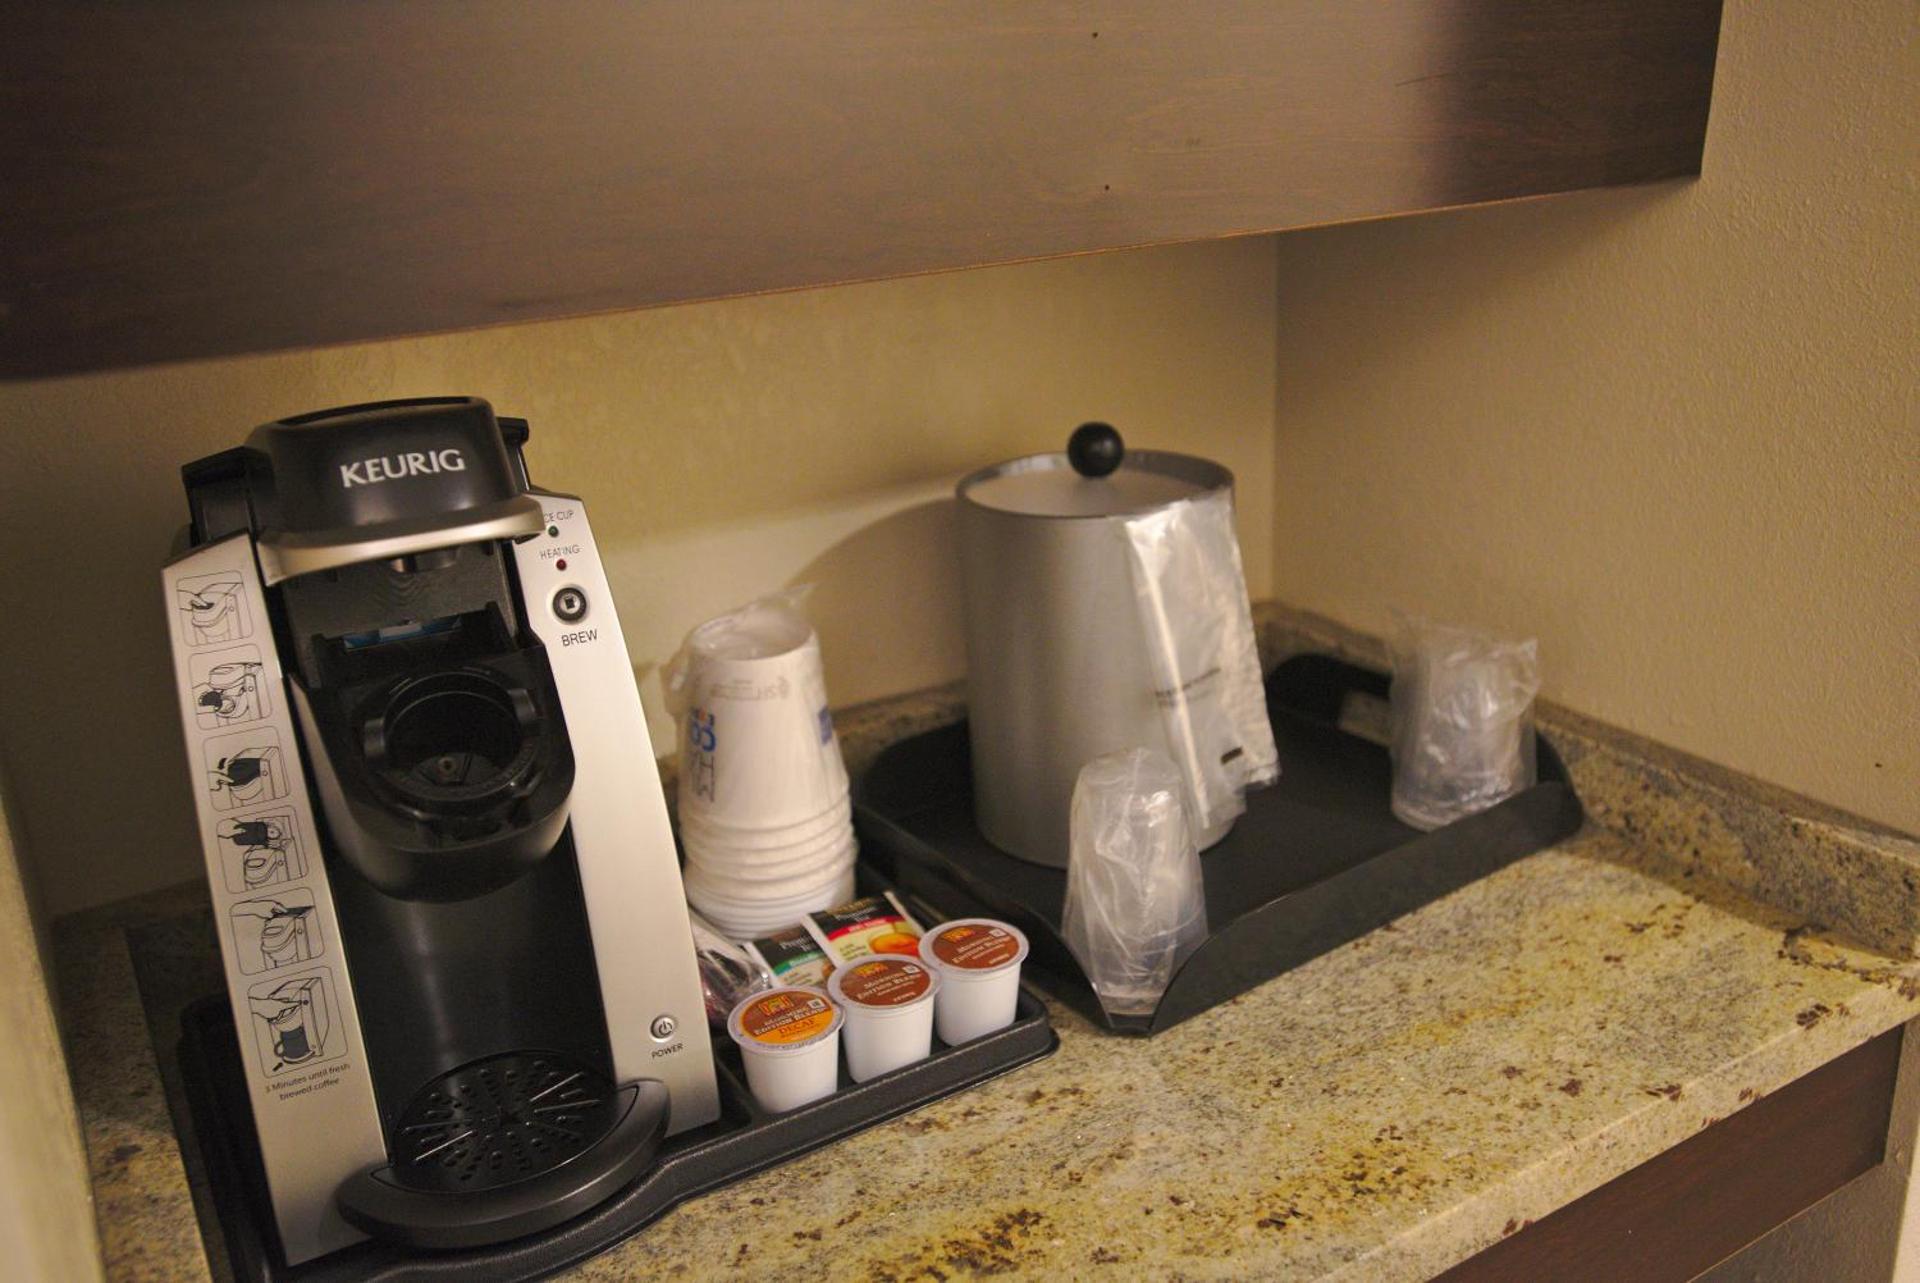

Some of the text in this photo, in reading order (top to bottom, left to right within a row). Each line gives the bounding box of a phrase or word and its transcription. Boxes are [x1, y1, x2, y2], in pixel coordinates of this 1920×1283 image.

[340, 449, 466, 487] KEURIG
[557, 510, 574, 520] CUP
[540, 545, 581, 559] HEATING
[561, 629, 598, 647] BREW
[651, 1042, 683, 1060] POWER
[272, 1075, 307, 1090] Minutes
[308, 1068, 328, 1080] until
[329, 1063, 351, 1073] fresh
[280, 1078, 339, 1101] brewed coffee
